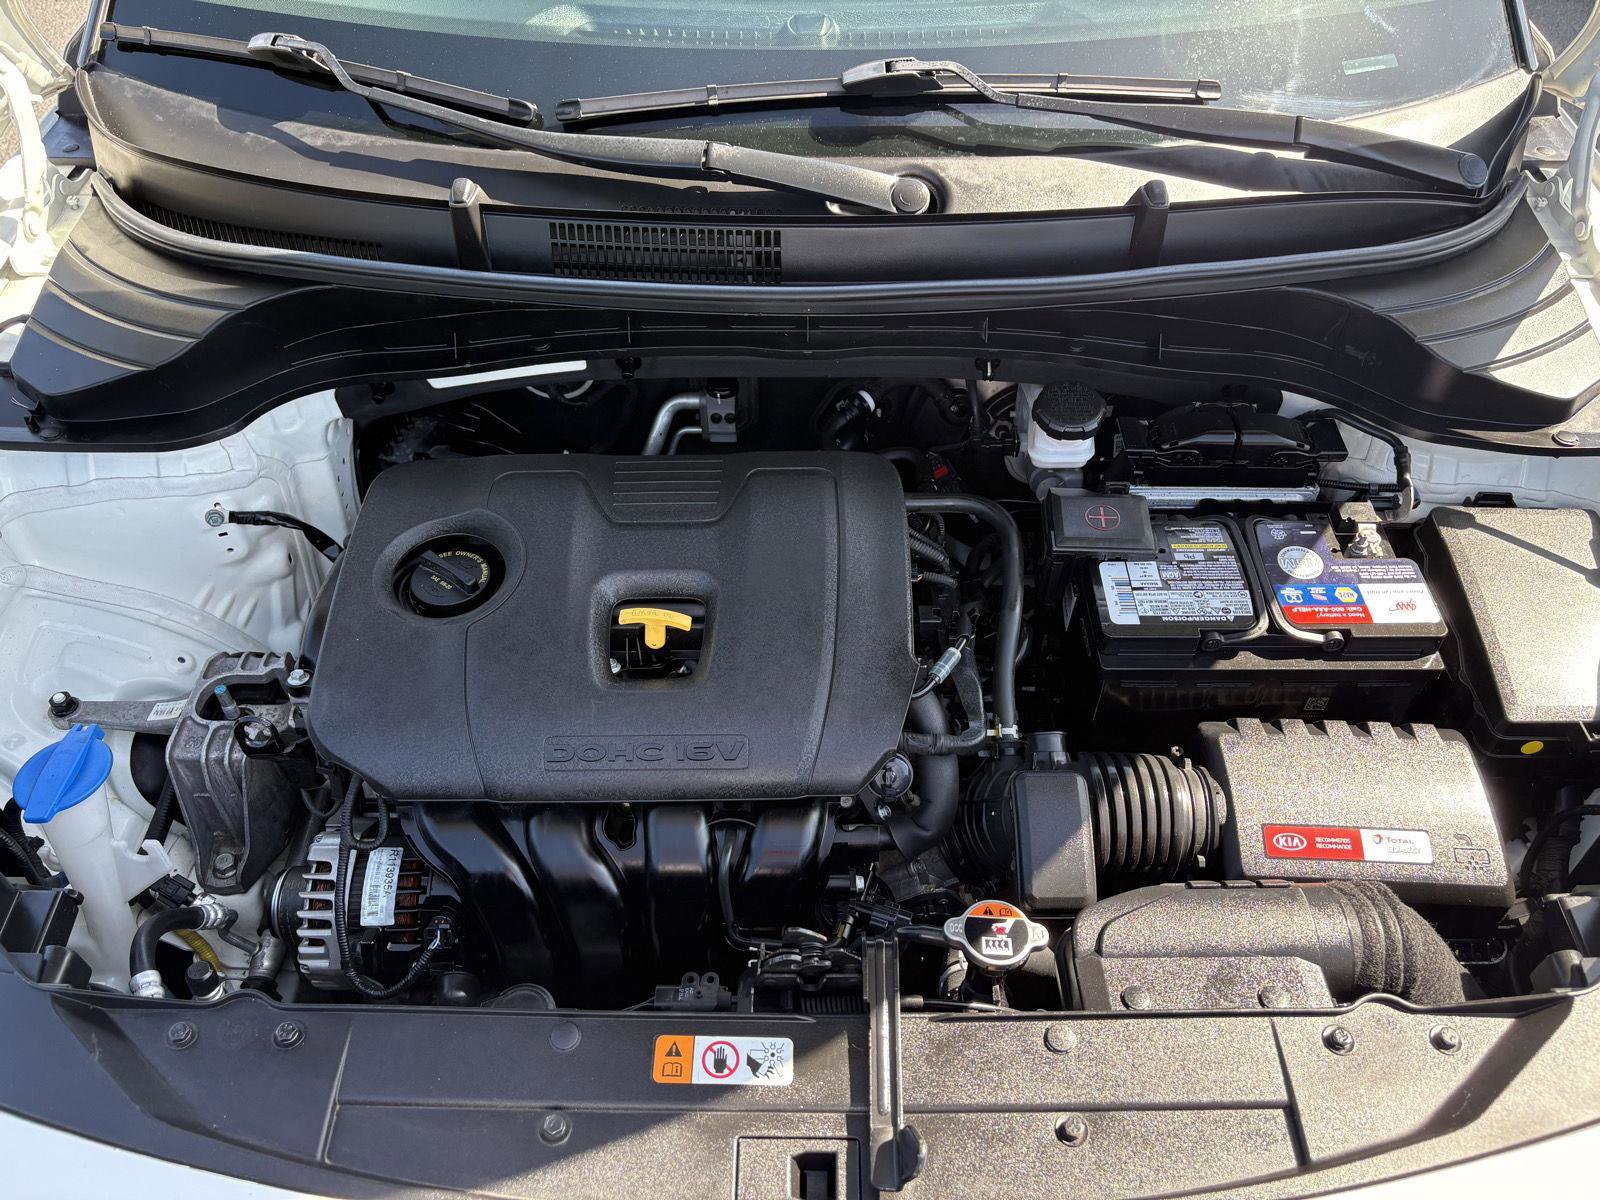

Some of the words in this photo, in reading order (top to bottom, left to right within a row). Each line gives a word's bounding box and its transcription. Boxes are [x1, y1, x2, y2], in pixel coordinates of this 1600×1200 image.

[455, 550, 483, 564] OWNER'S
[546, 742, 665, 763] DOHC
[675, 741, 745, 762] 16V
[1278, 835, 1302, 847] KIA
[1386, 837, 1415, 845] TOTAL
